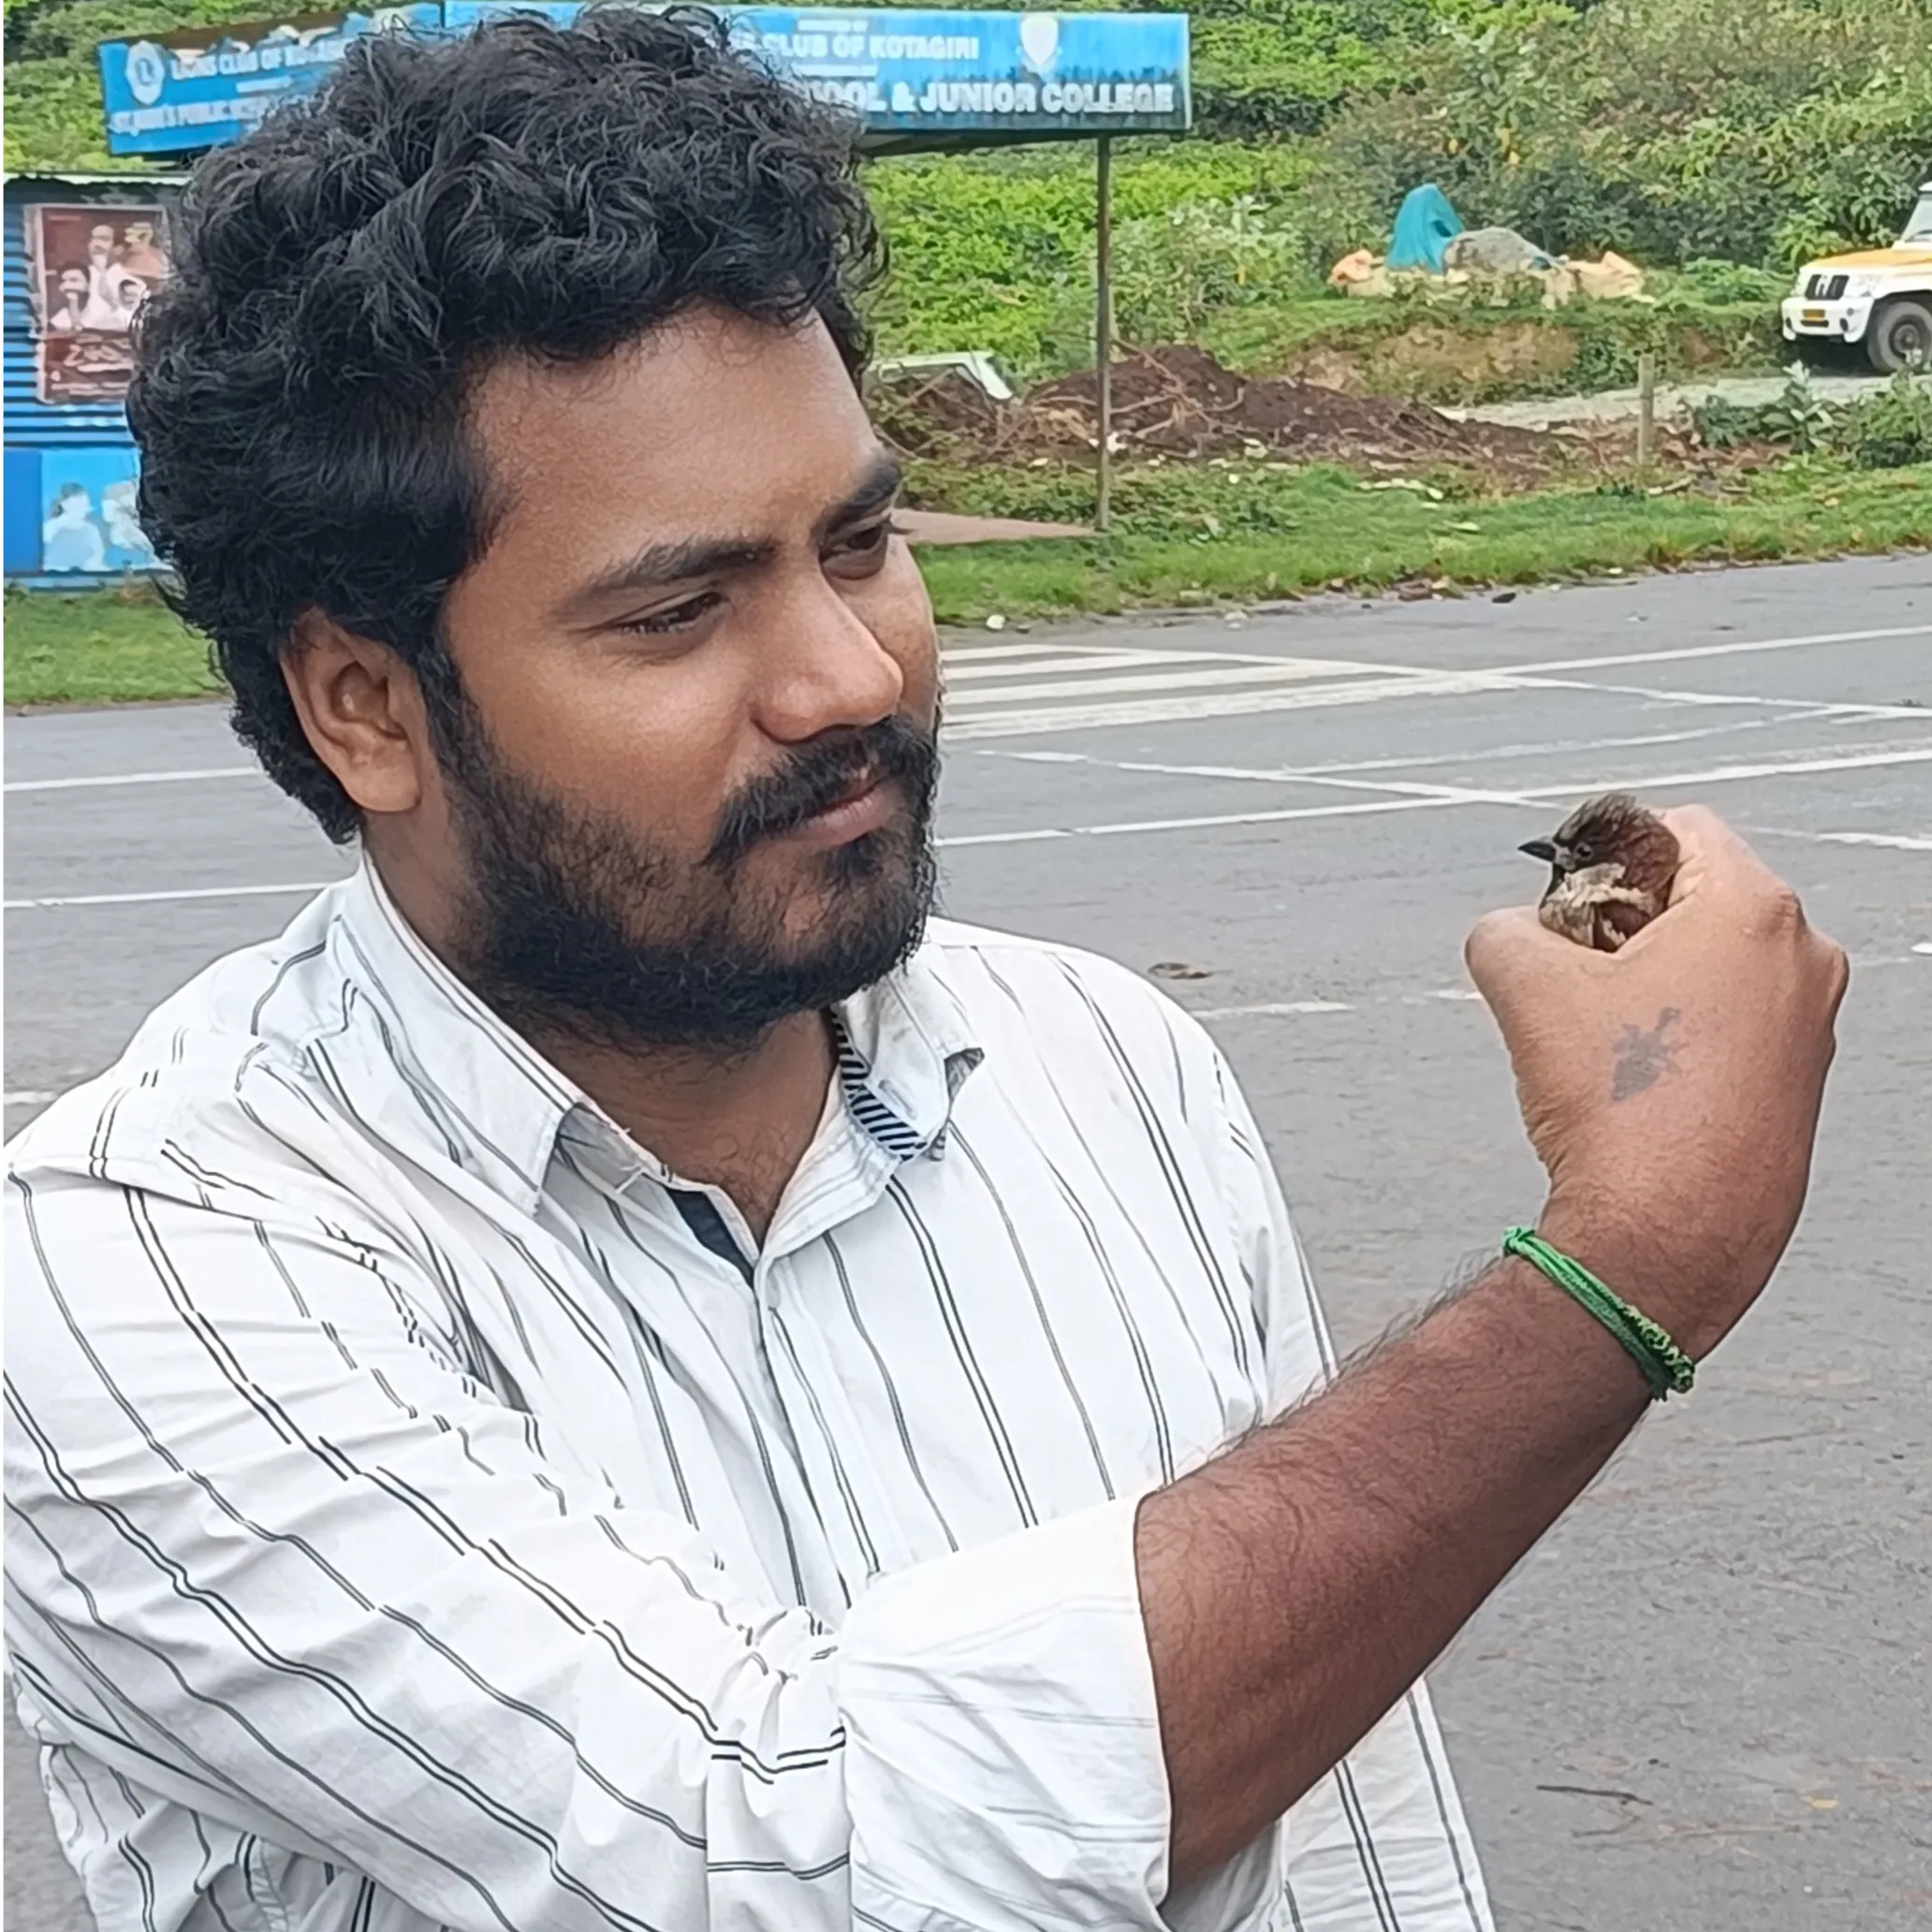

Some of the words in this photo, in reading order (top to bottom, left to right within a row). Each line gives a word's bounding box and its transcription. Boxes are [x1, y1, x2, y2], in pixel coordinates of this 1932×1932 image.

[891, 81, 916, 112] &
[919, 81, 1036, 113] JUNIOR
[1042, 82, 1175, 113] COLLEGE
